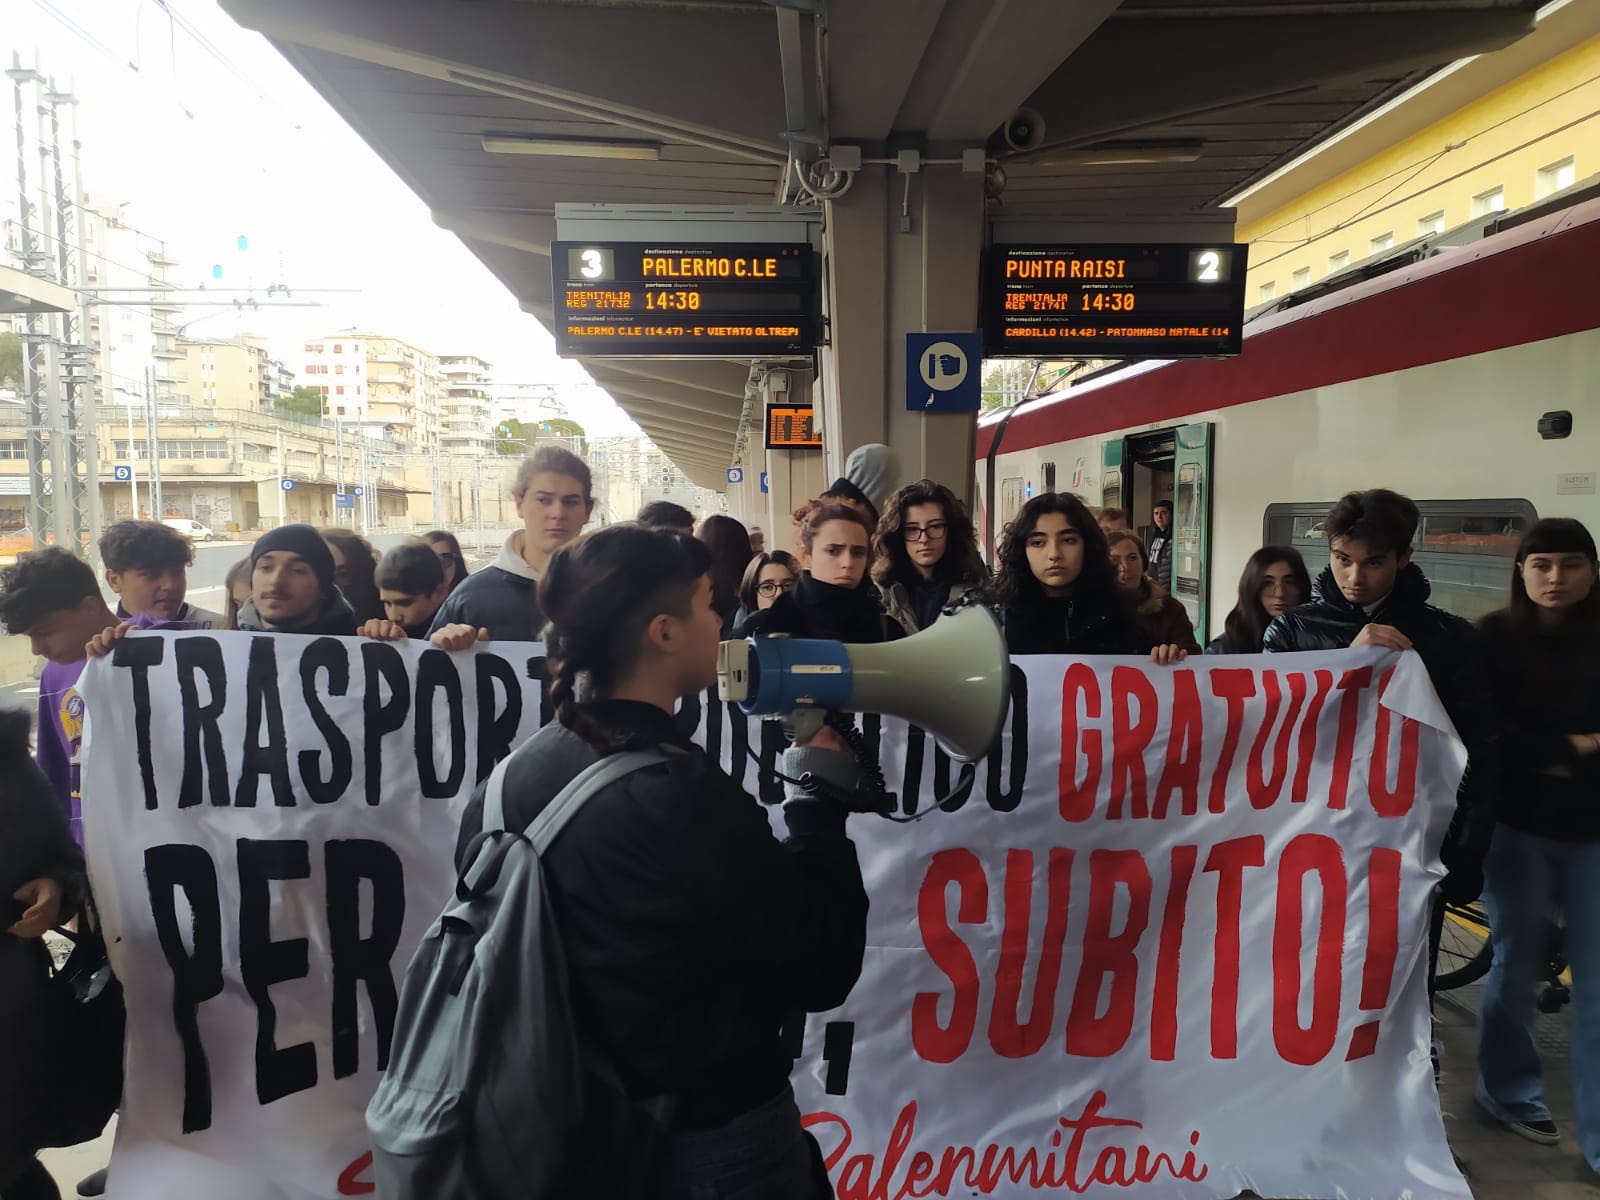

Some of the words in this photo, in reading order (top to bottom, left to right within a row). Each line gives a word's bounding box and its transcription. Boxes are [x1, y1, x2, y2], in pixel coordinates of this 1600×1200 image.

[581, 250, 603, 278] 3
[642, 258, 730, 277] PALERMO
[734, 258, 777, 277] C.LE
[1006, 260, 1066, 279] PUNTA
[1070, 260, 1126, 279] RAISI
[1198, 252, 1220, 280] 2
[566, 291, 632, 300] TRENITALIA
[566, 300, 588, 309] REG
[595, 300, 631, 309] 21732
[645, 292, 701, 310] 14:30
[1006, 293, 1068, 302] TRENITALIA
[1082, 293, 1135, 311] 14:30
[1005, 301, 1026, 310] REG
[1033, 301, 1066, 310] 21741
[567, 326, 615, 337] PALERMO
[618, 326, 642, 337] C.LE
[645, 326, 684, 337] (14.47)
[707, 326, 753, 337] VIETATO
[1005, 327, 1057, 337] CARDILLO
[1060, 327, 1097, 337] (14.42)
[1169, 327, 1209, 337] NATALE
[112, 636, 552, 811] TRASPOR
[1058, 662, 1419, 823] GRATUITO
[144, 838, 406, 1134] PER
[911, 833, 1402, 1066] SUBITO!
